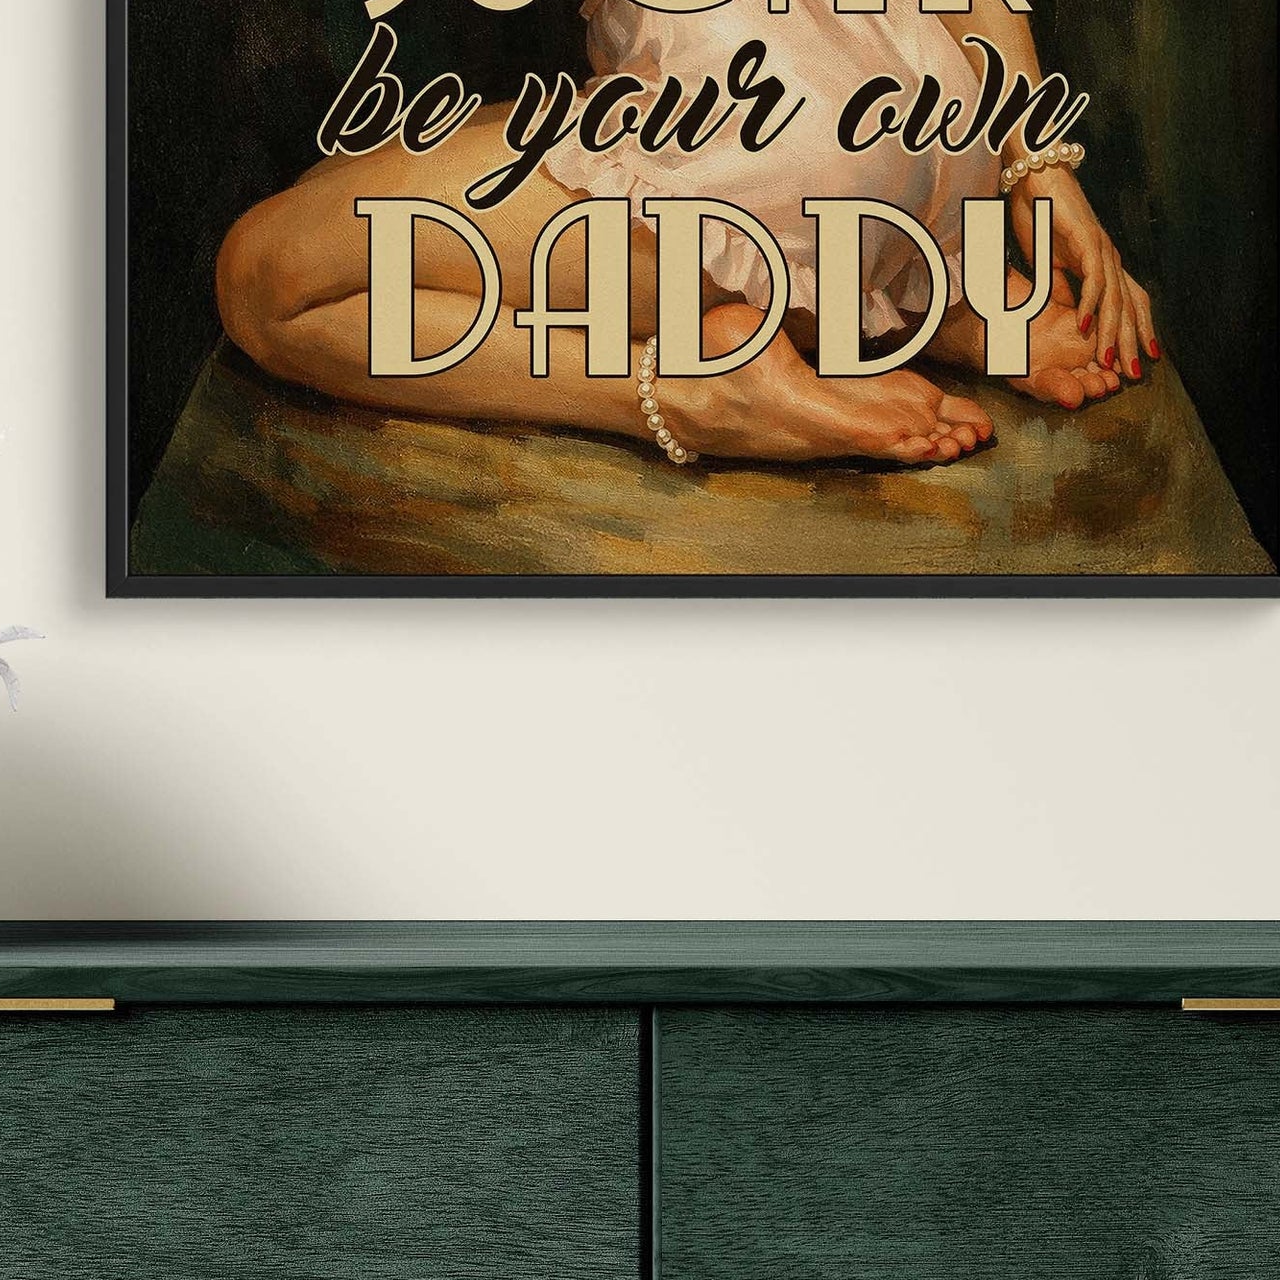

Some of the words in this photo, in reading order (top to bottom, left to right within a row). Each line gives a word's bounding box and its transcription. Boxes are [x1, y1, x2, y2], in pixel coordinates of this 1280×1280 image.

[318, 22, 481, 157] be
[464, 39, 806, 211] your
[837, 34, 1089, 155] own
[354, 196, 1054, 379] DADDY
